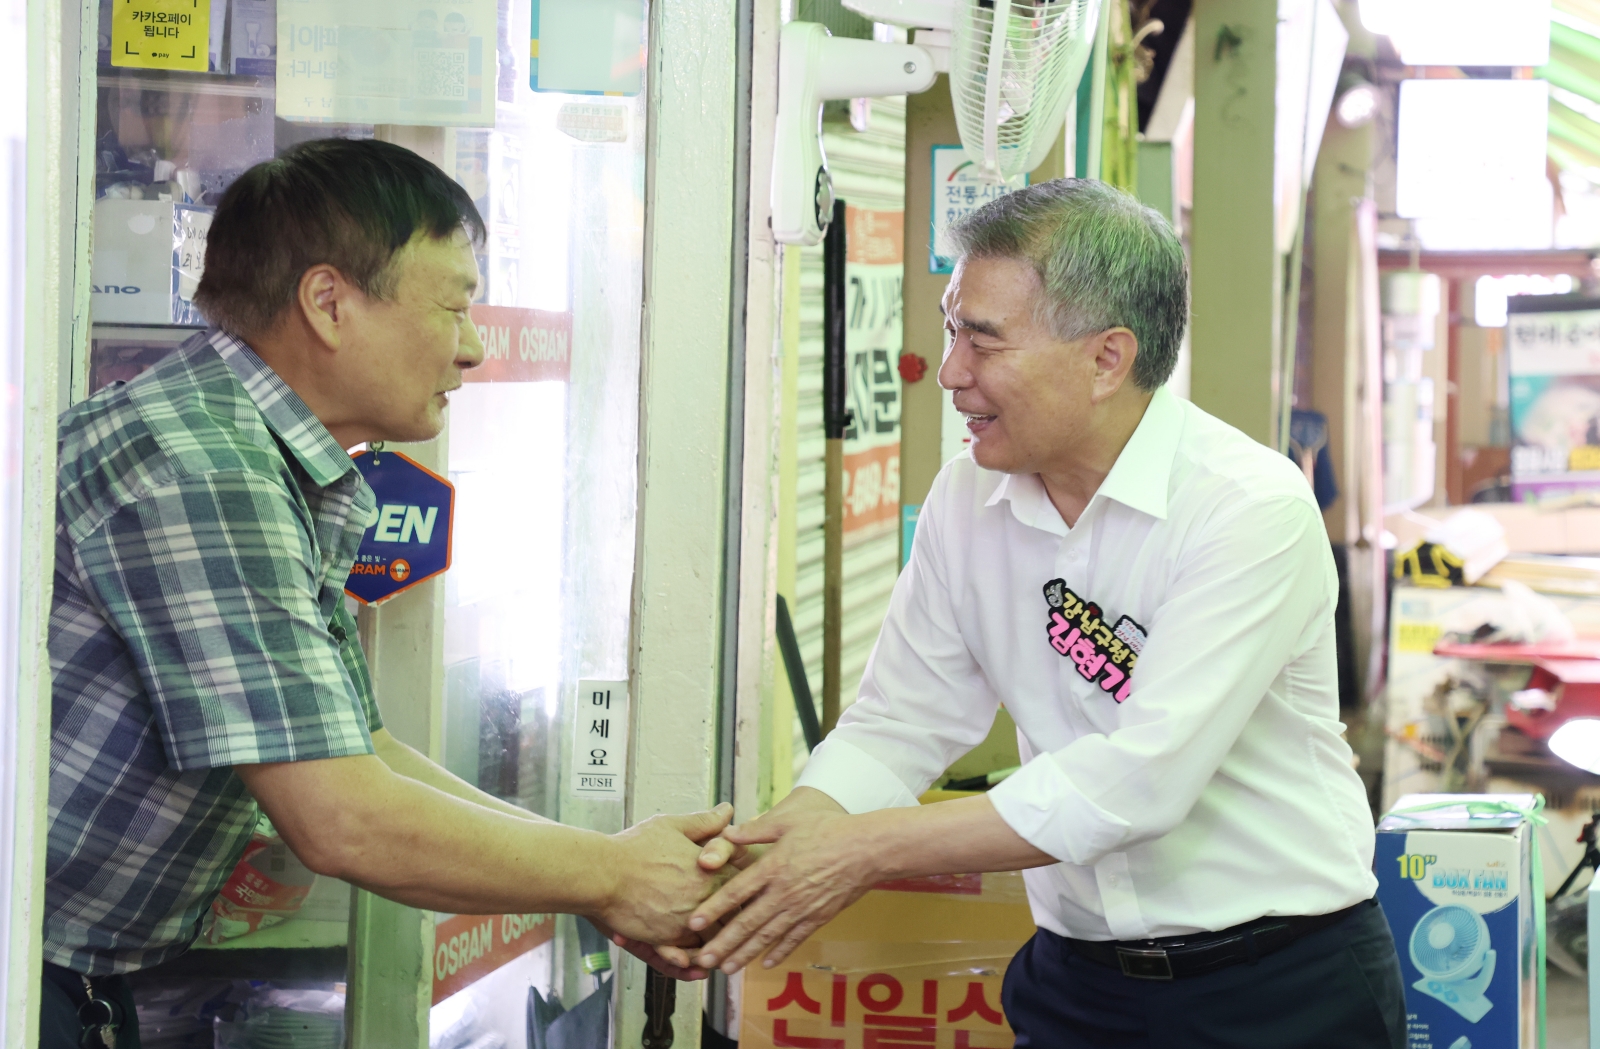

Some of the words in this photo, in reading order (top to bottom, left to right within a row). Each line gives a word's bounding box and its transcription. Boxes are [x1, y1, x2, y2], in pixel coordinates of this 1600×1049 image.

[132, 10, 191, 26] 카카오페이
[143, 25, 180, 39] 됩니다
[519, 326, 568, 363] OSRAM
[1049, 611, 1132, 703] 김현기
[588, 690, 611, 766] 미세요
[581, 777, 613, 787] PUSH
[1432, 868, 1470, 889] BOX
[1473, 869, 1508, 891] FAN
[435, 918, 493, 980] OSRAM
